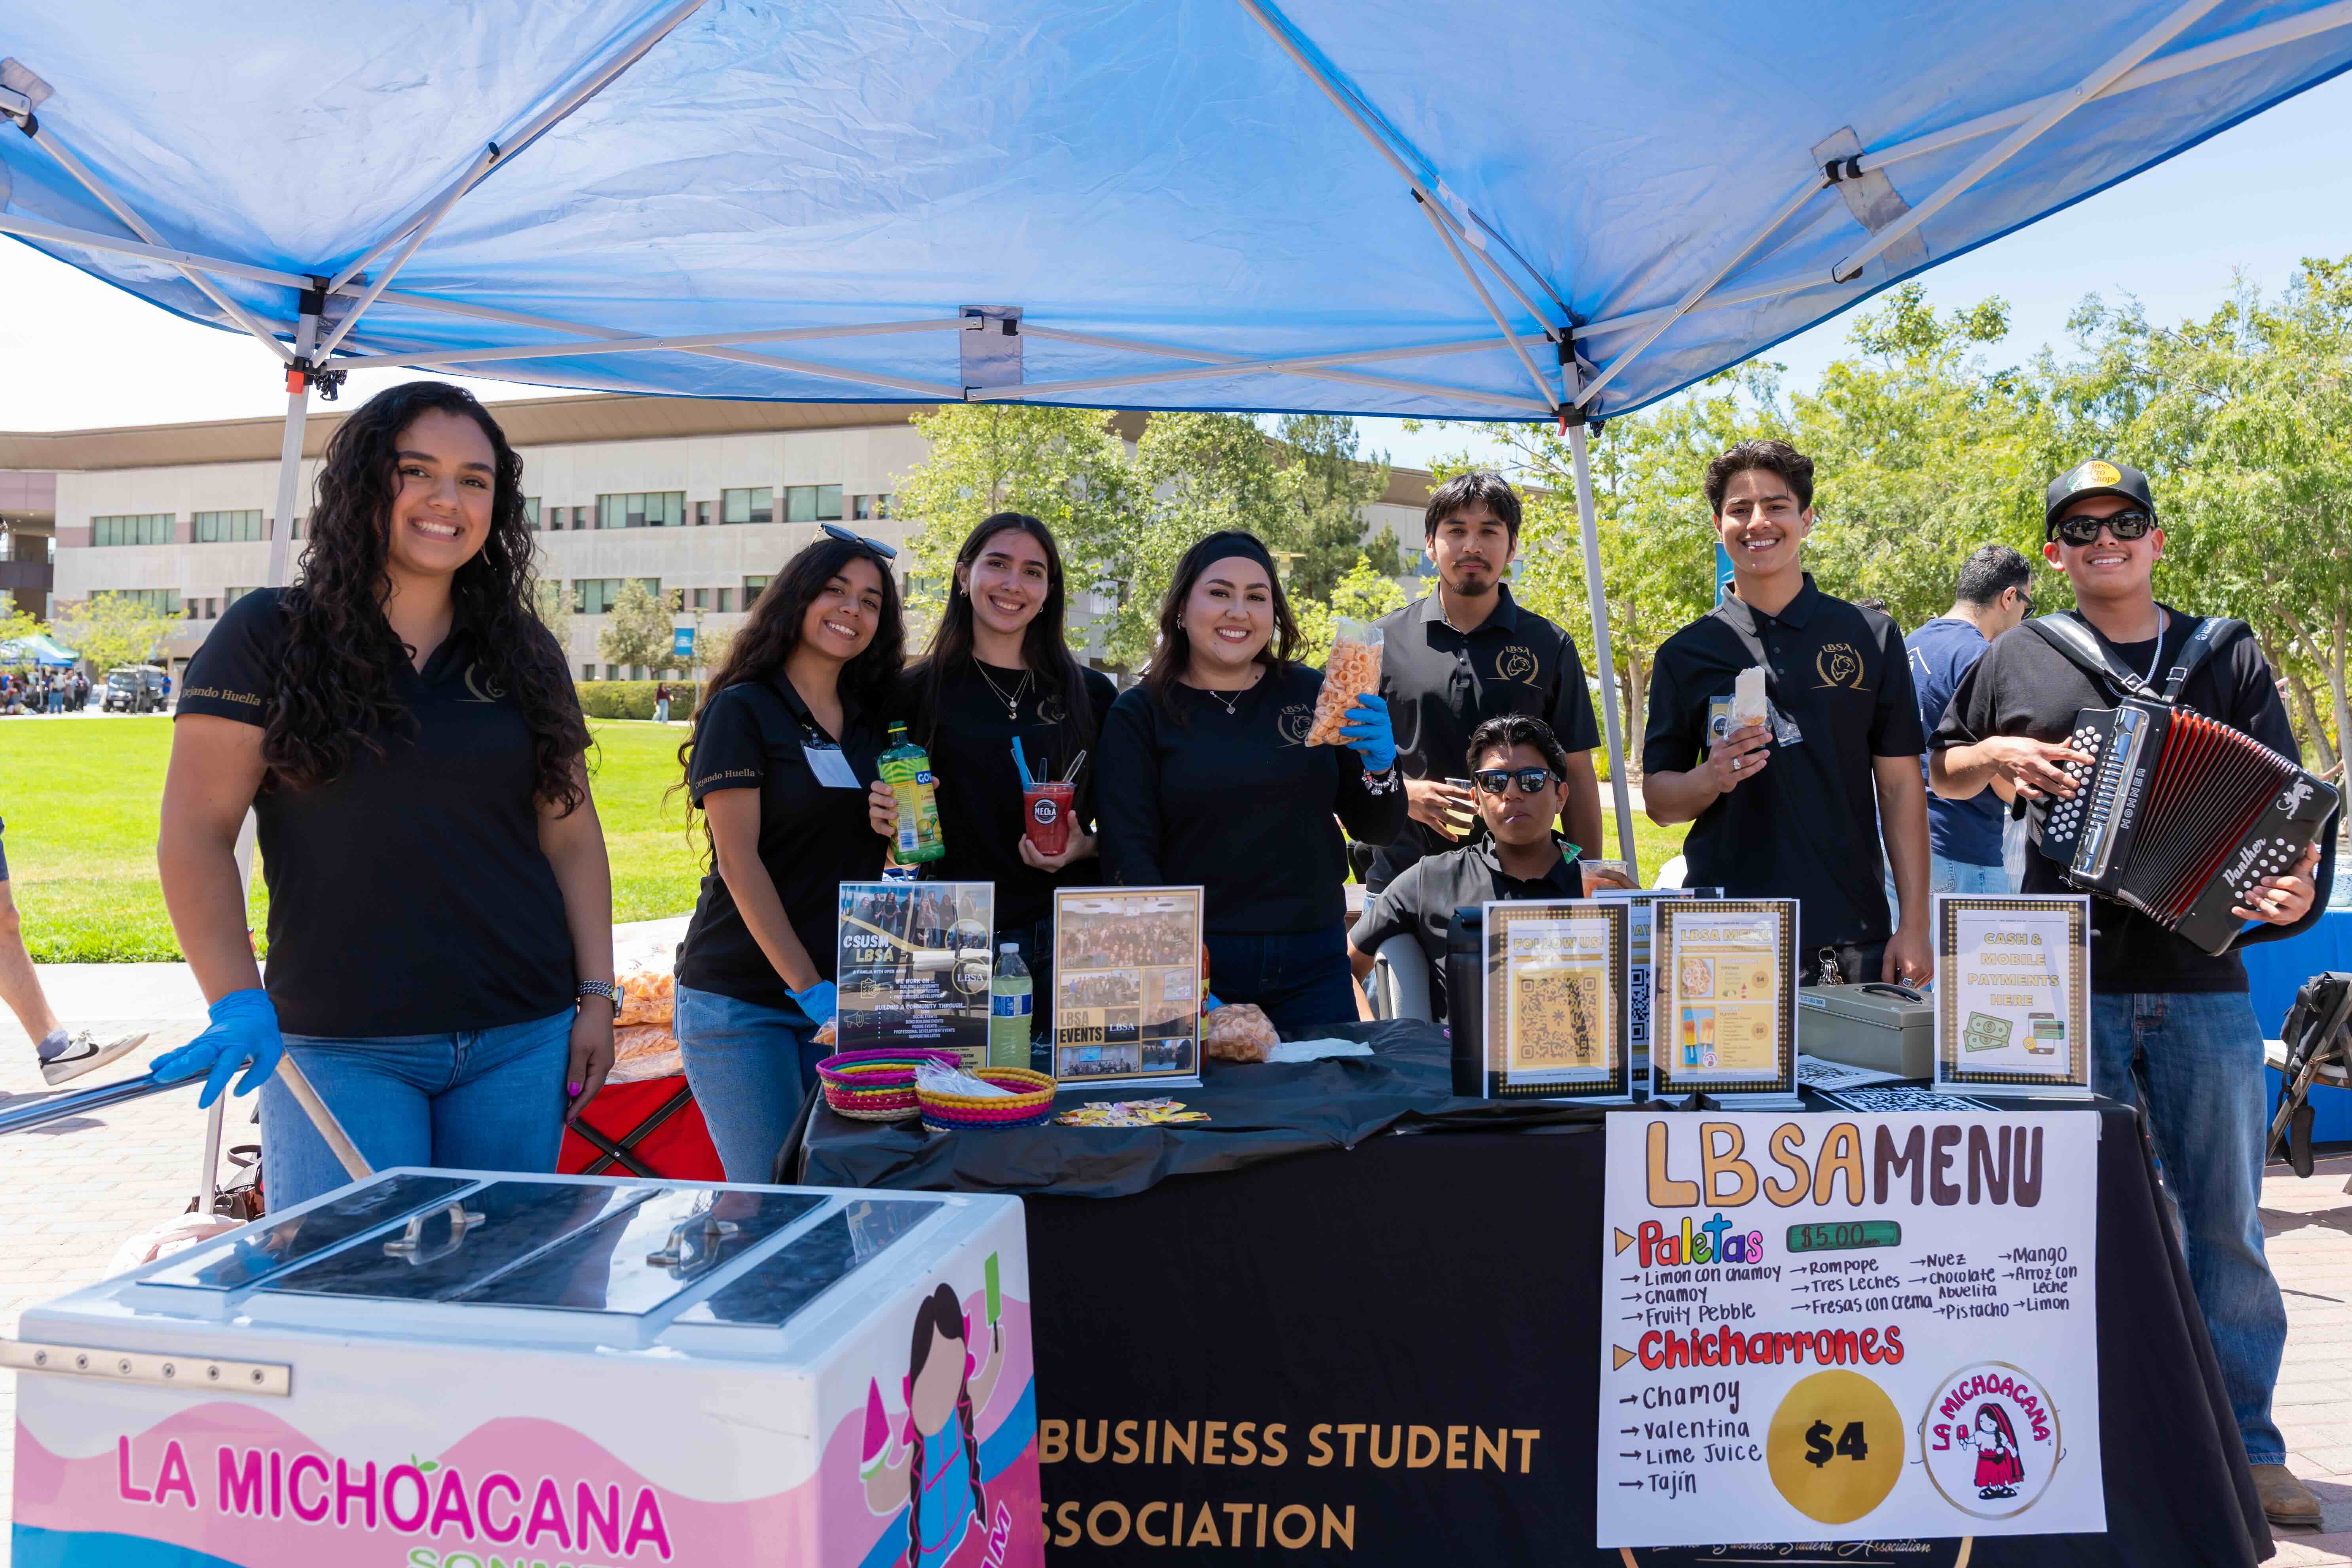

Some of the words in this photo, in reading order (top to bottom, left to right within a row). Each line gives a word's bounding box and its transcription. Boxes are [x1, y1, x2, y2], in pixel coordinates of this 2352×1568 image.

[1505, 645, 1532, 657] LBSA
[1821, 643, 1855, 654] LBSA
[221, 689, 261, 706] Huella
[1281, 703, 1311, 715] LBSA
[725, 768, 755, 778] Huella
[2120, 768, 2147, 830] HOHNER
[2222, 837, 2267, 887] Panther
[1631, 924, 1651, 936] AY
[1680, 928, 1720, 942] LBSA
[1723, 928, 1772, 942] MENU
[843, 934, 889, 948] CSUSM
[1513, 937, 1577, 950] FOLLOW
[1579, 936, 1604, 949] US!
[1984, 932, 2027, 945] CASH
[2031, 933, 2043, 945] &
[856, 948, 894, 962] LBSA
[1981, 953, 2046, 966] MOBILE
[1967, 974, 2059, 987] PAYMENTS
[1990, 994, 2033, 1006] HERE
[1060, 1011, 1089, 1027] LBSA
[1109, 1022, 1135, 1032] LBSA
[1060, 1027, 1102, 1043] EVENTS
[1646, 1121, 1866, 1208] LBSA
[1873, 1124, 2044, 1207] MENU
[1638, 1212, 1764, 1268] Paletas
[1801, 1223, 1864, 1248] $5.00
[1927, 1253, 1967, 1267] Nuez
[2012, 1246, 2067, 1266] Mango
[1809, 1259, 1879, 1275] Rompope
[2015, 1266, 2052, 1281] Arroz
[2056, 1265, 2077, 1279] con
[1645, 1269, 1691, 1286] Limon
[1695, 1268, 1721, 1282] con
[1811, 1279, 1844, 1293] Tres
[1849, 1275, 1900, 1291] Leches
[1939, 1284, 1997, 1299] Abuelita
[2033, 1281, 2068, 1294] Leche
[1812, 1298, 1862, 1314] Fresas
[1866, 1297, 1888, 1312] con
[1946, 1302, 2009, 1319] Pistacho
[2027, 1297, 2069, 1311] Limon
[1646, 1306, 1690, 1327] Fruity
[1699, 1302, 1756, 1323] Pebble
[1638, 1325, 1904, 1371] Chicharrones
[1643, 1380, 1740, 1414] Chamoy
[1939, 1373, 2051, 1441] MICHOACANA
[1644, 1418, 1750, 1440] Valentina
[1932, 1424, 1951, 1450] LA
[1038, 1418, 1288, 1467] BUSINESS
[1306, 1422, 1541, 1474] STUDENT
[1804, 1419, 1868, 1468] $4
[1646, 1448, 1695, 1465] Lime
[1703, 1443, 1762, 1463] Juice
[118, 1435, 197, 1509] LA
[216, 1444, 674, 1560] MICHOACANA
